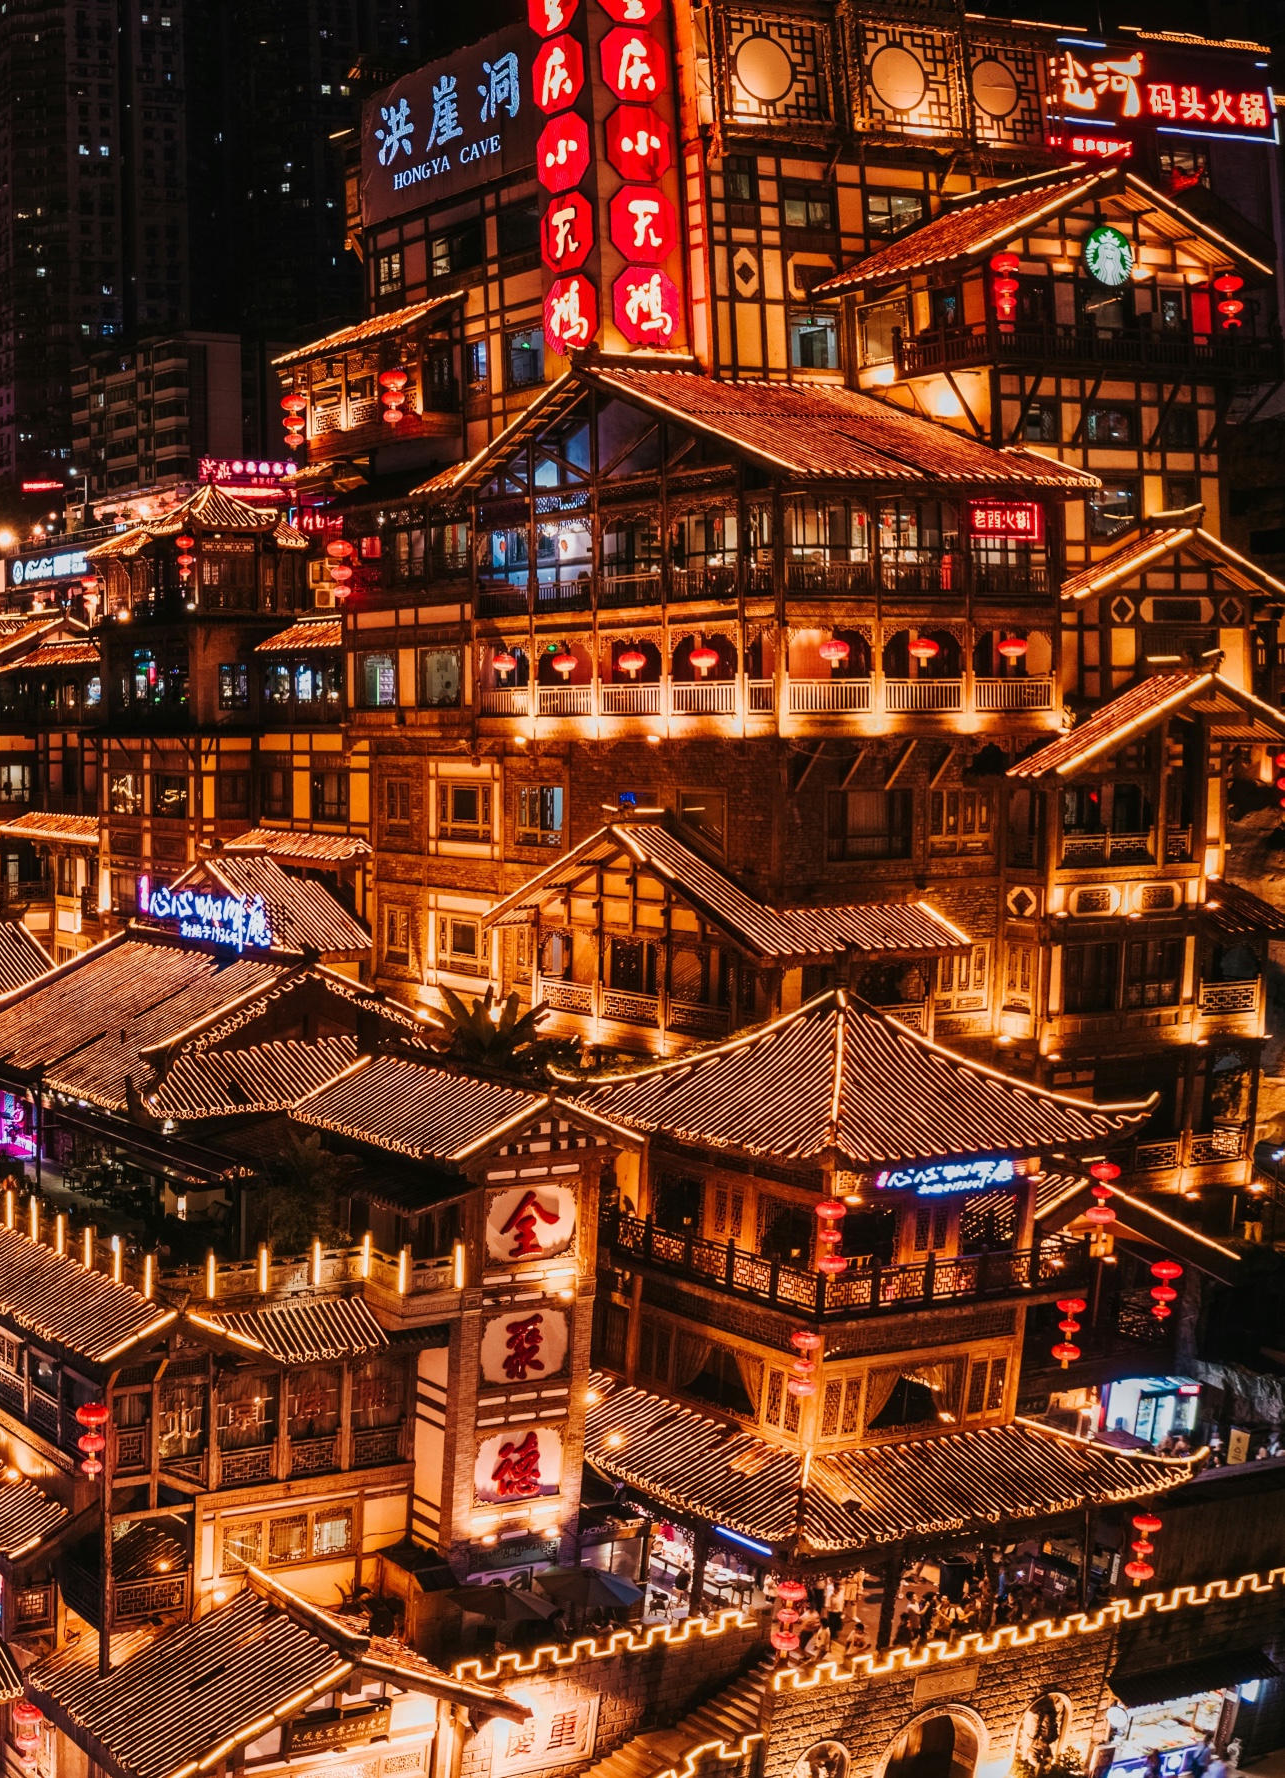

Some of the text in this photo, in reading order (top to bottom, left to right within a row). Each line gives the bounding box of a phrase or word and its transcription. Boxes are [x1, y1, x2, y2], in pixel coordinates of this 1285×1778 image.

[375, 52, 521, 166] 洪崖洞
[1147, 84, 1266, 127] 码头火锅
[393, 134, 501, 191] HONGYA CAVE
